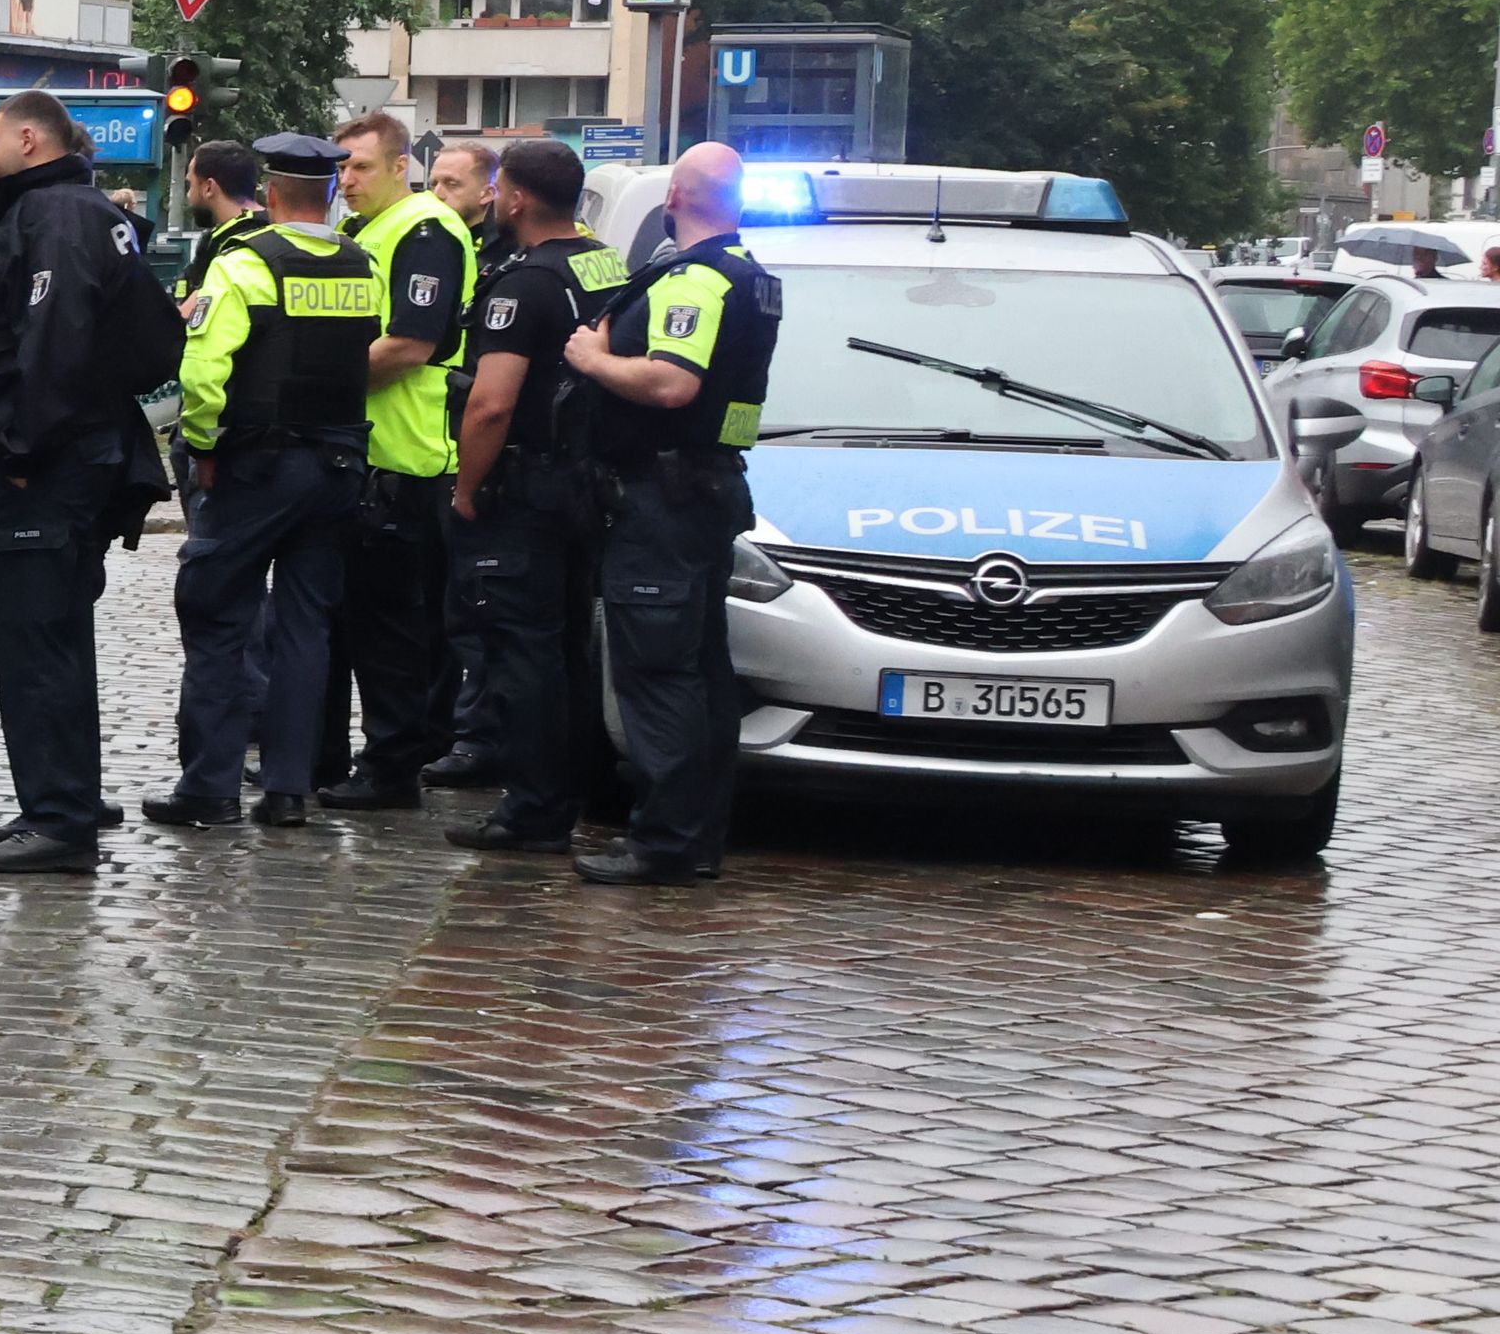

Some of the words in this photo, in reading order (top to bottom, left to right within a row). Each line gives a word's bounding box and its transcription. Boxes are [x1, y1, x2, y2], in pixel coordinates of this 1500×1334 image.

[723, 51, 751, 84] U
[572, 250, 629, 288] POLIZE
[290, 282, 371, 311] POLIZEI
[846, 505, 1148, 552] POLIZEI
[922, 680, 945, 714] B
[971, 684, 1087, 722] 30565
